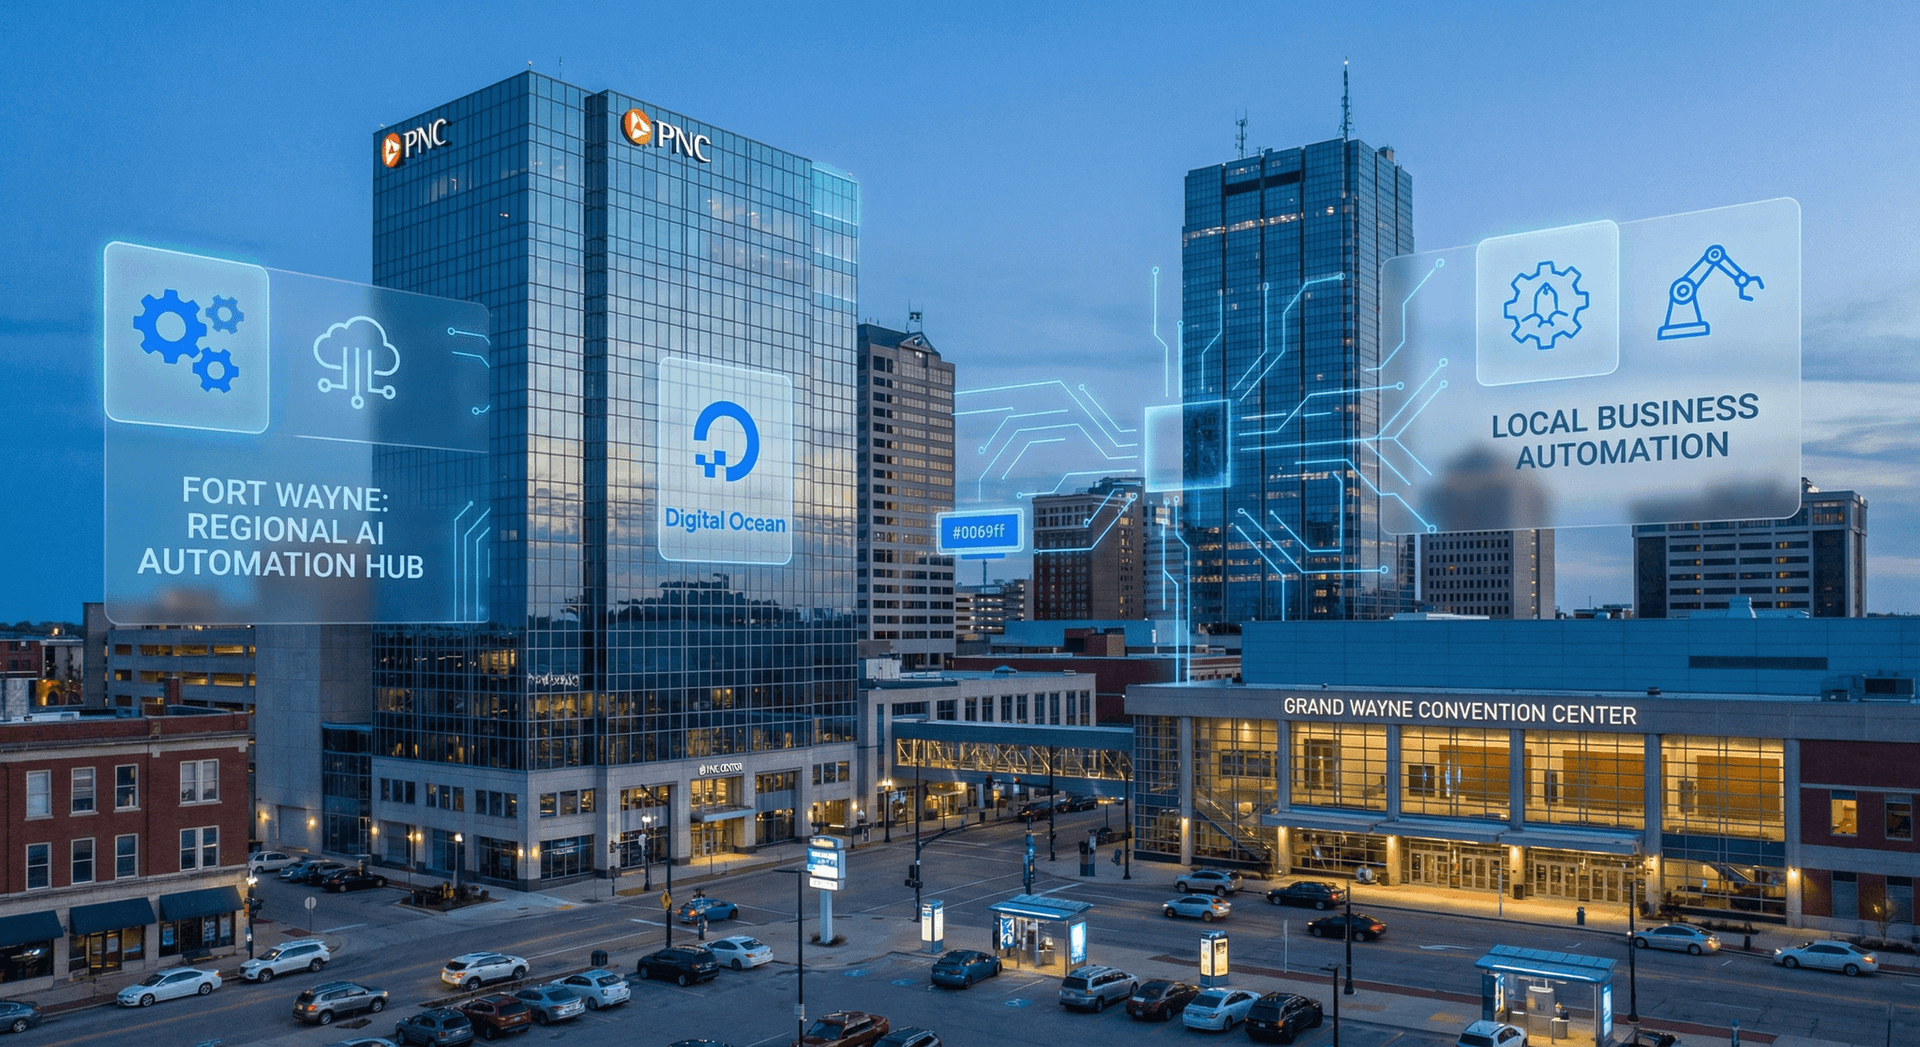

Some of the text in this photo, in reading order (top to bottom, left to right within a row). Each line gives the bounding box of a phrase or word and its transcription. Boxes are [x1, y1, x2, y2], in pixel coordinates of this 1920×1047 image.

[403, 118, 447, 158] PNC
[655, 119, 712, 163] PNC
[1283, 697, 1637, 726] GRAND WAYNE CONVENTION CENTER
